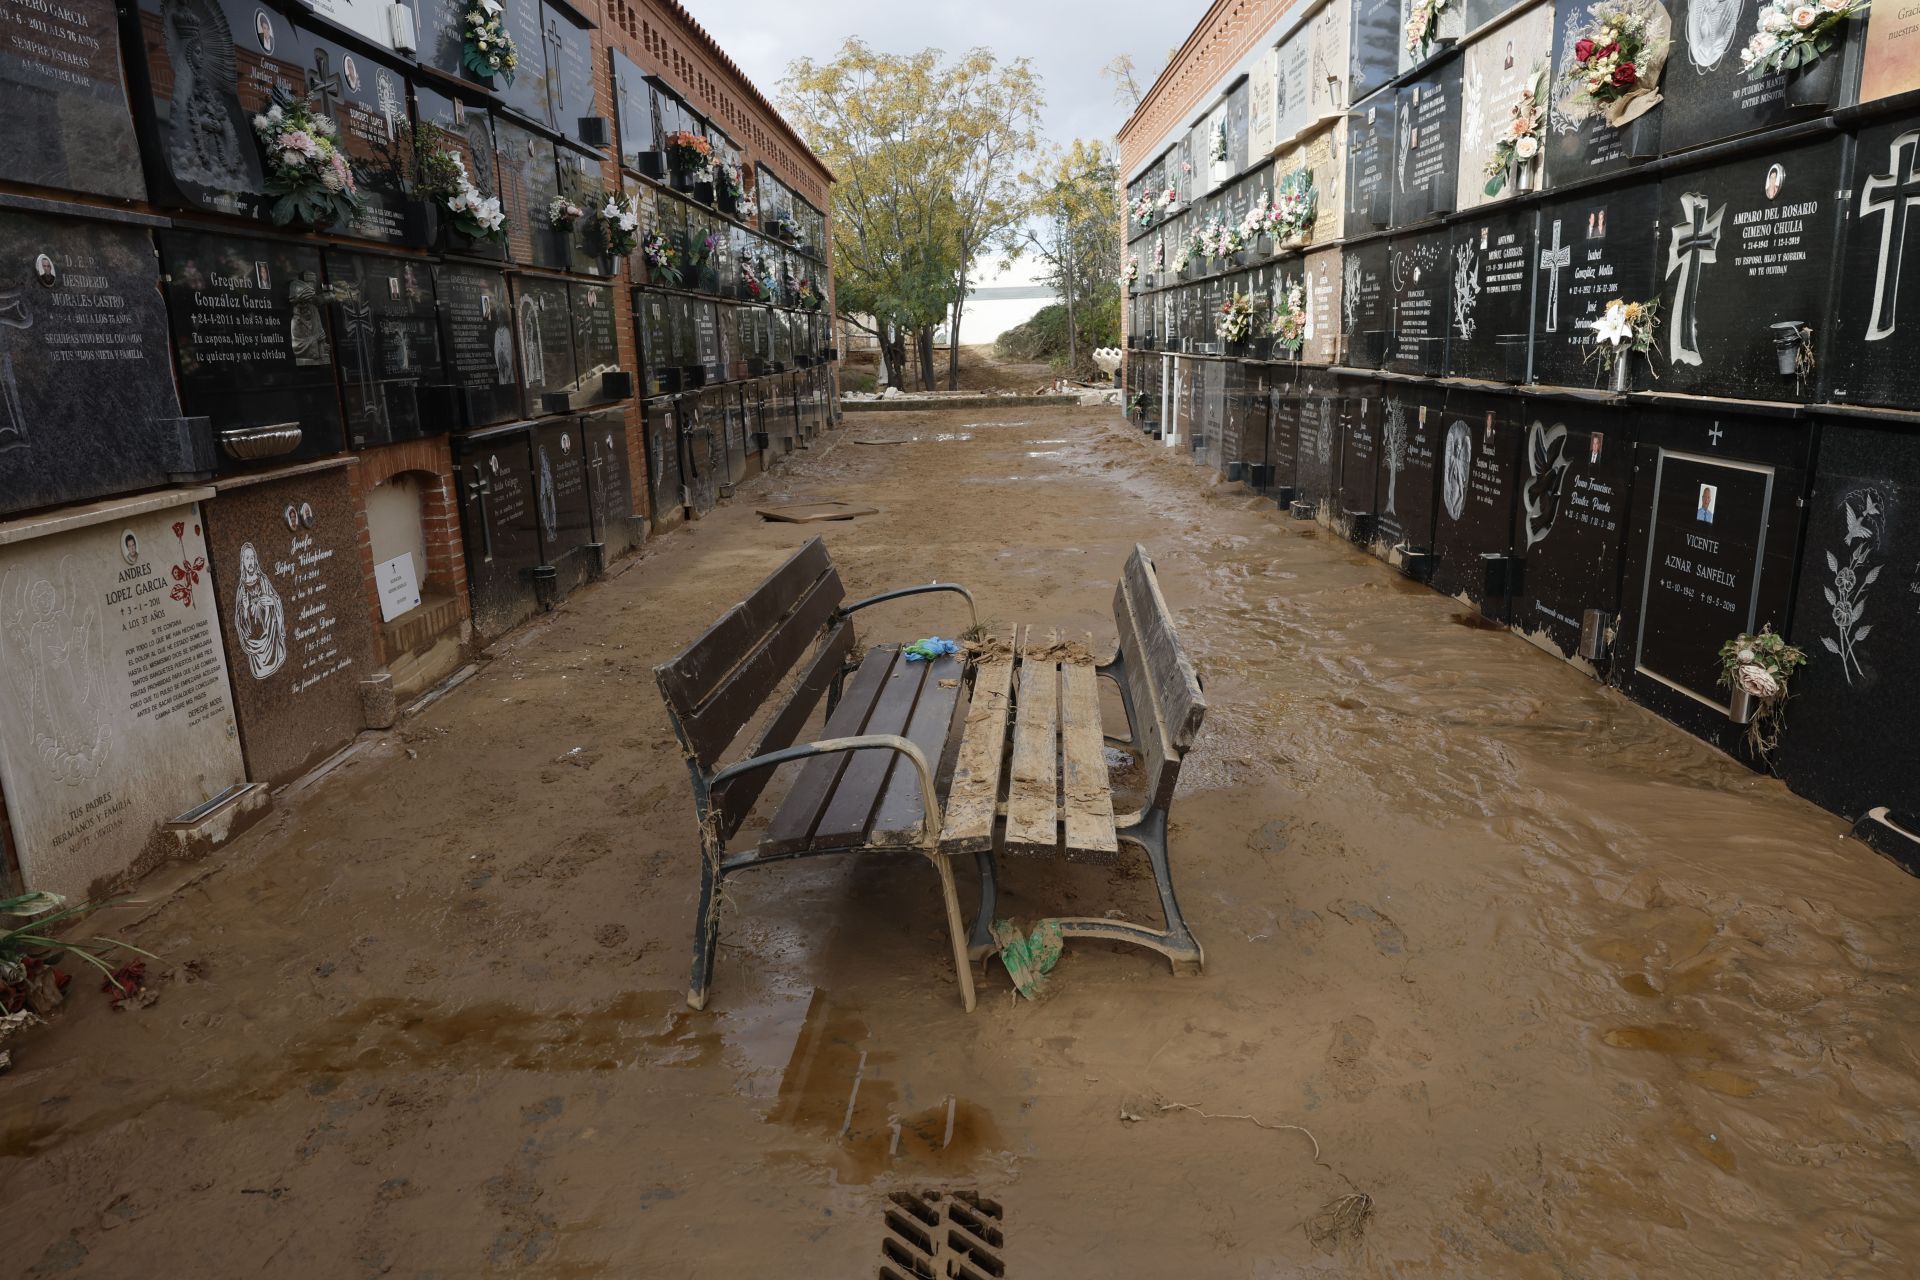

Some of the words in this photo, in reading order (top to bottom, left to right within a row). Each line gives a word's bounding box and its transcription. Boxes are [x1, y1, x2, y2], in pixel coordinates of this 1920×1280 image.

[1733, 210, 1762, 225] AMPARO
[1764, 207, 1780, 220] DEL
[1782, 201, 1818, 218] ROSARIO
[1742, 224, 1772, 238] GIMENO
[1774, 220, 1803, 234] CHULIA
[62, 274, 108, 288] DESIDERIO
[210, 272, 253, 290] Gregorio
[1749, 268, 1757, 276] NO
[1758, 266, 1764, 276] TE
[52, 293, 92, 307] MORALES
[94, 295, 124, 308] CASTRO
[194, 292, 240, 308] González
[242, 294, 272, 308] García
[1686, 533, 1720, 554] VICENTE
[118, 562, 152, 584] ANDRES
[1664, 554, 1692, 574] AZNAR
[1696, 564, 1736, 588] SANFÉLIX
[106, 587, 132, 606] LOPEZ
[136, 576, 168, 597] GARCIA
[122, 624, 127, 632] A
[128, 618, 140, 630] LOS
[142, 615, 148, 625] 37
[150, 610, 166, 622] AÑOS
[69, 806, 83, 820] TUS
[85, 792, 112, 812] PADRES
[51, 818, 94, 847] HERMANOS
[104, 798, 132, 818] FAMILIA
